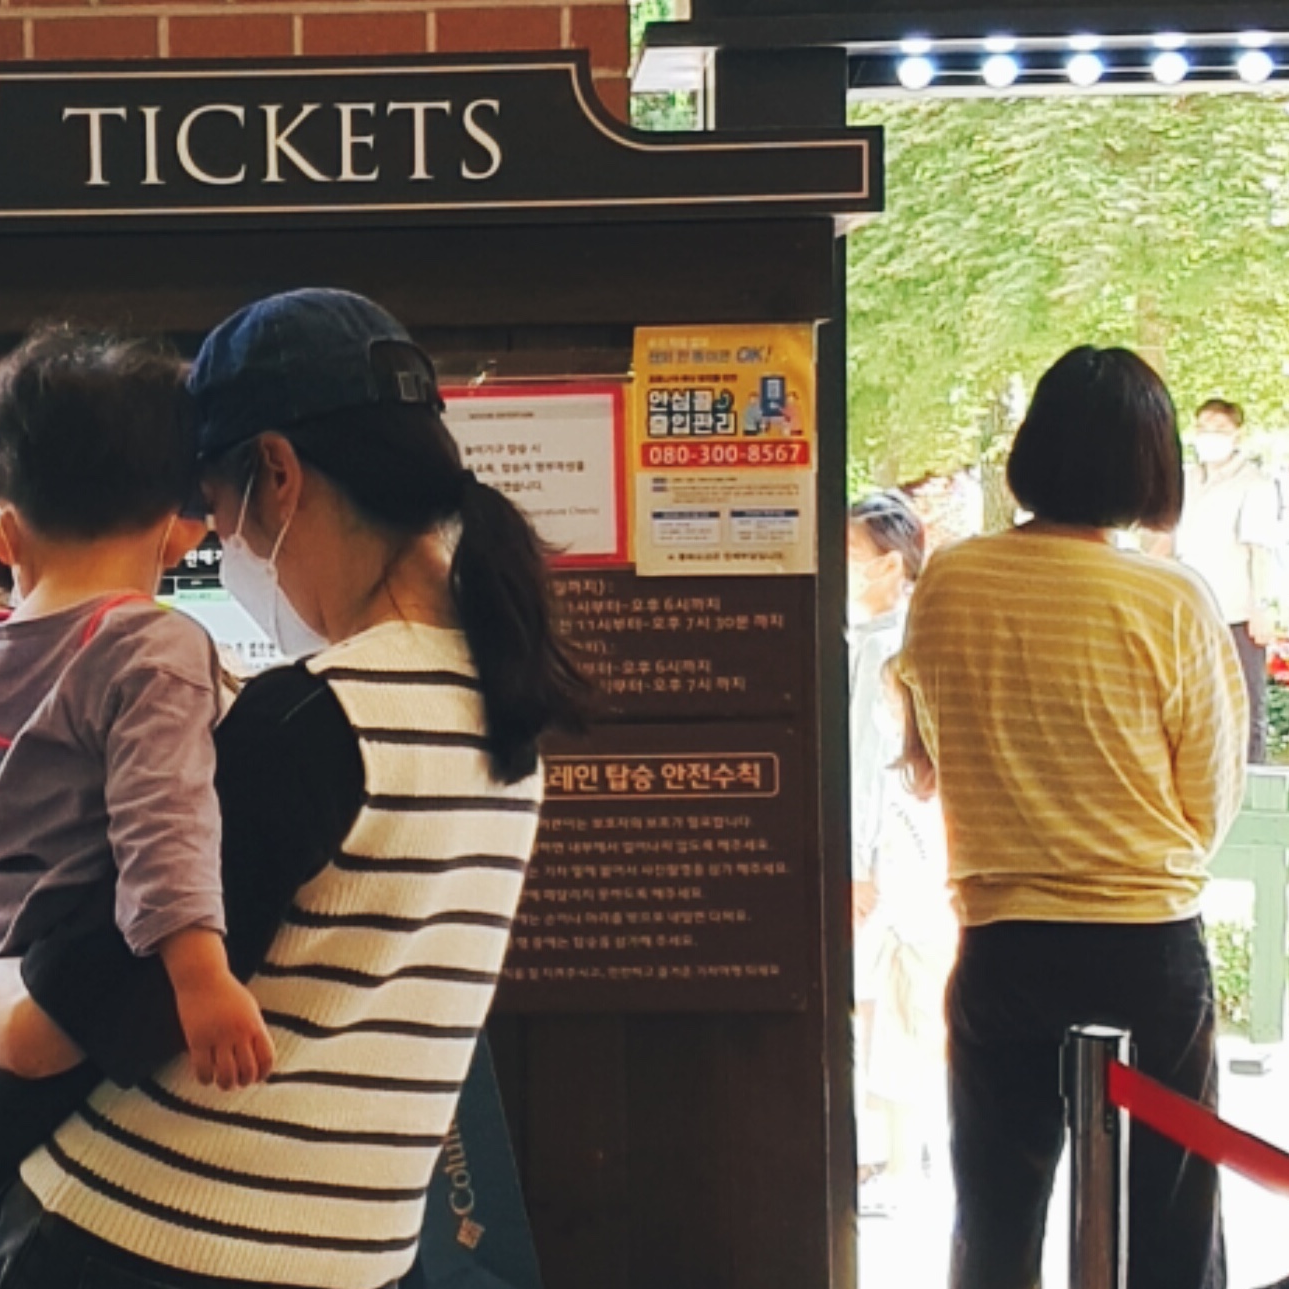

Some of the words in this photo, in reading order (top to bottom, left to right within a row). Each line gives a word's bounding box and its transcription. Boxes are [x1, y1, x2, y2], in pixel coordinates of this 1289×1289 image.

[61, 98, 503, 187] TICKETS
[649, 443, 802, 466] 080-300-8567
[605, 762, 655, 792] 탑승
[660, 761, 762, 791] 안전수칙
